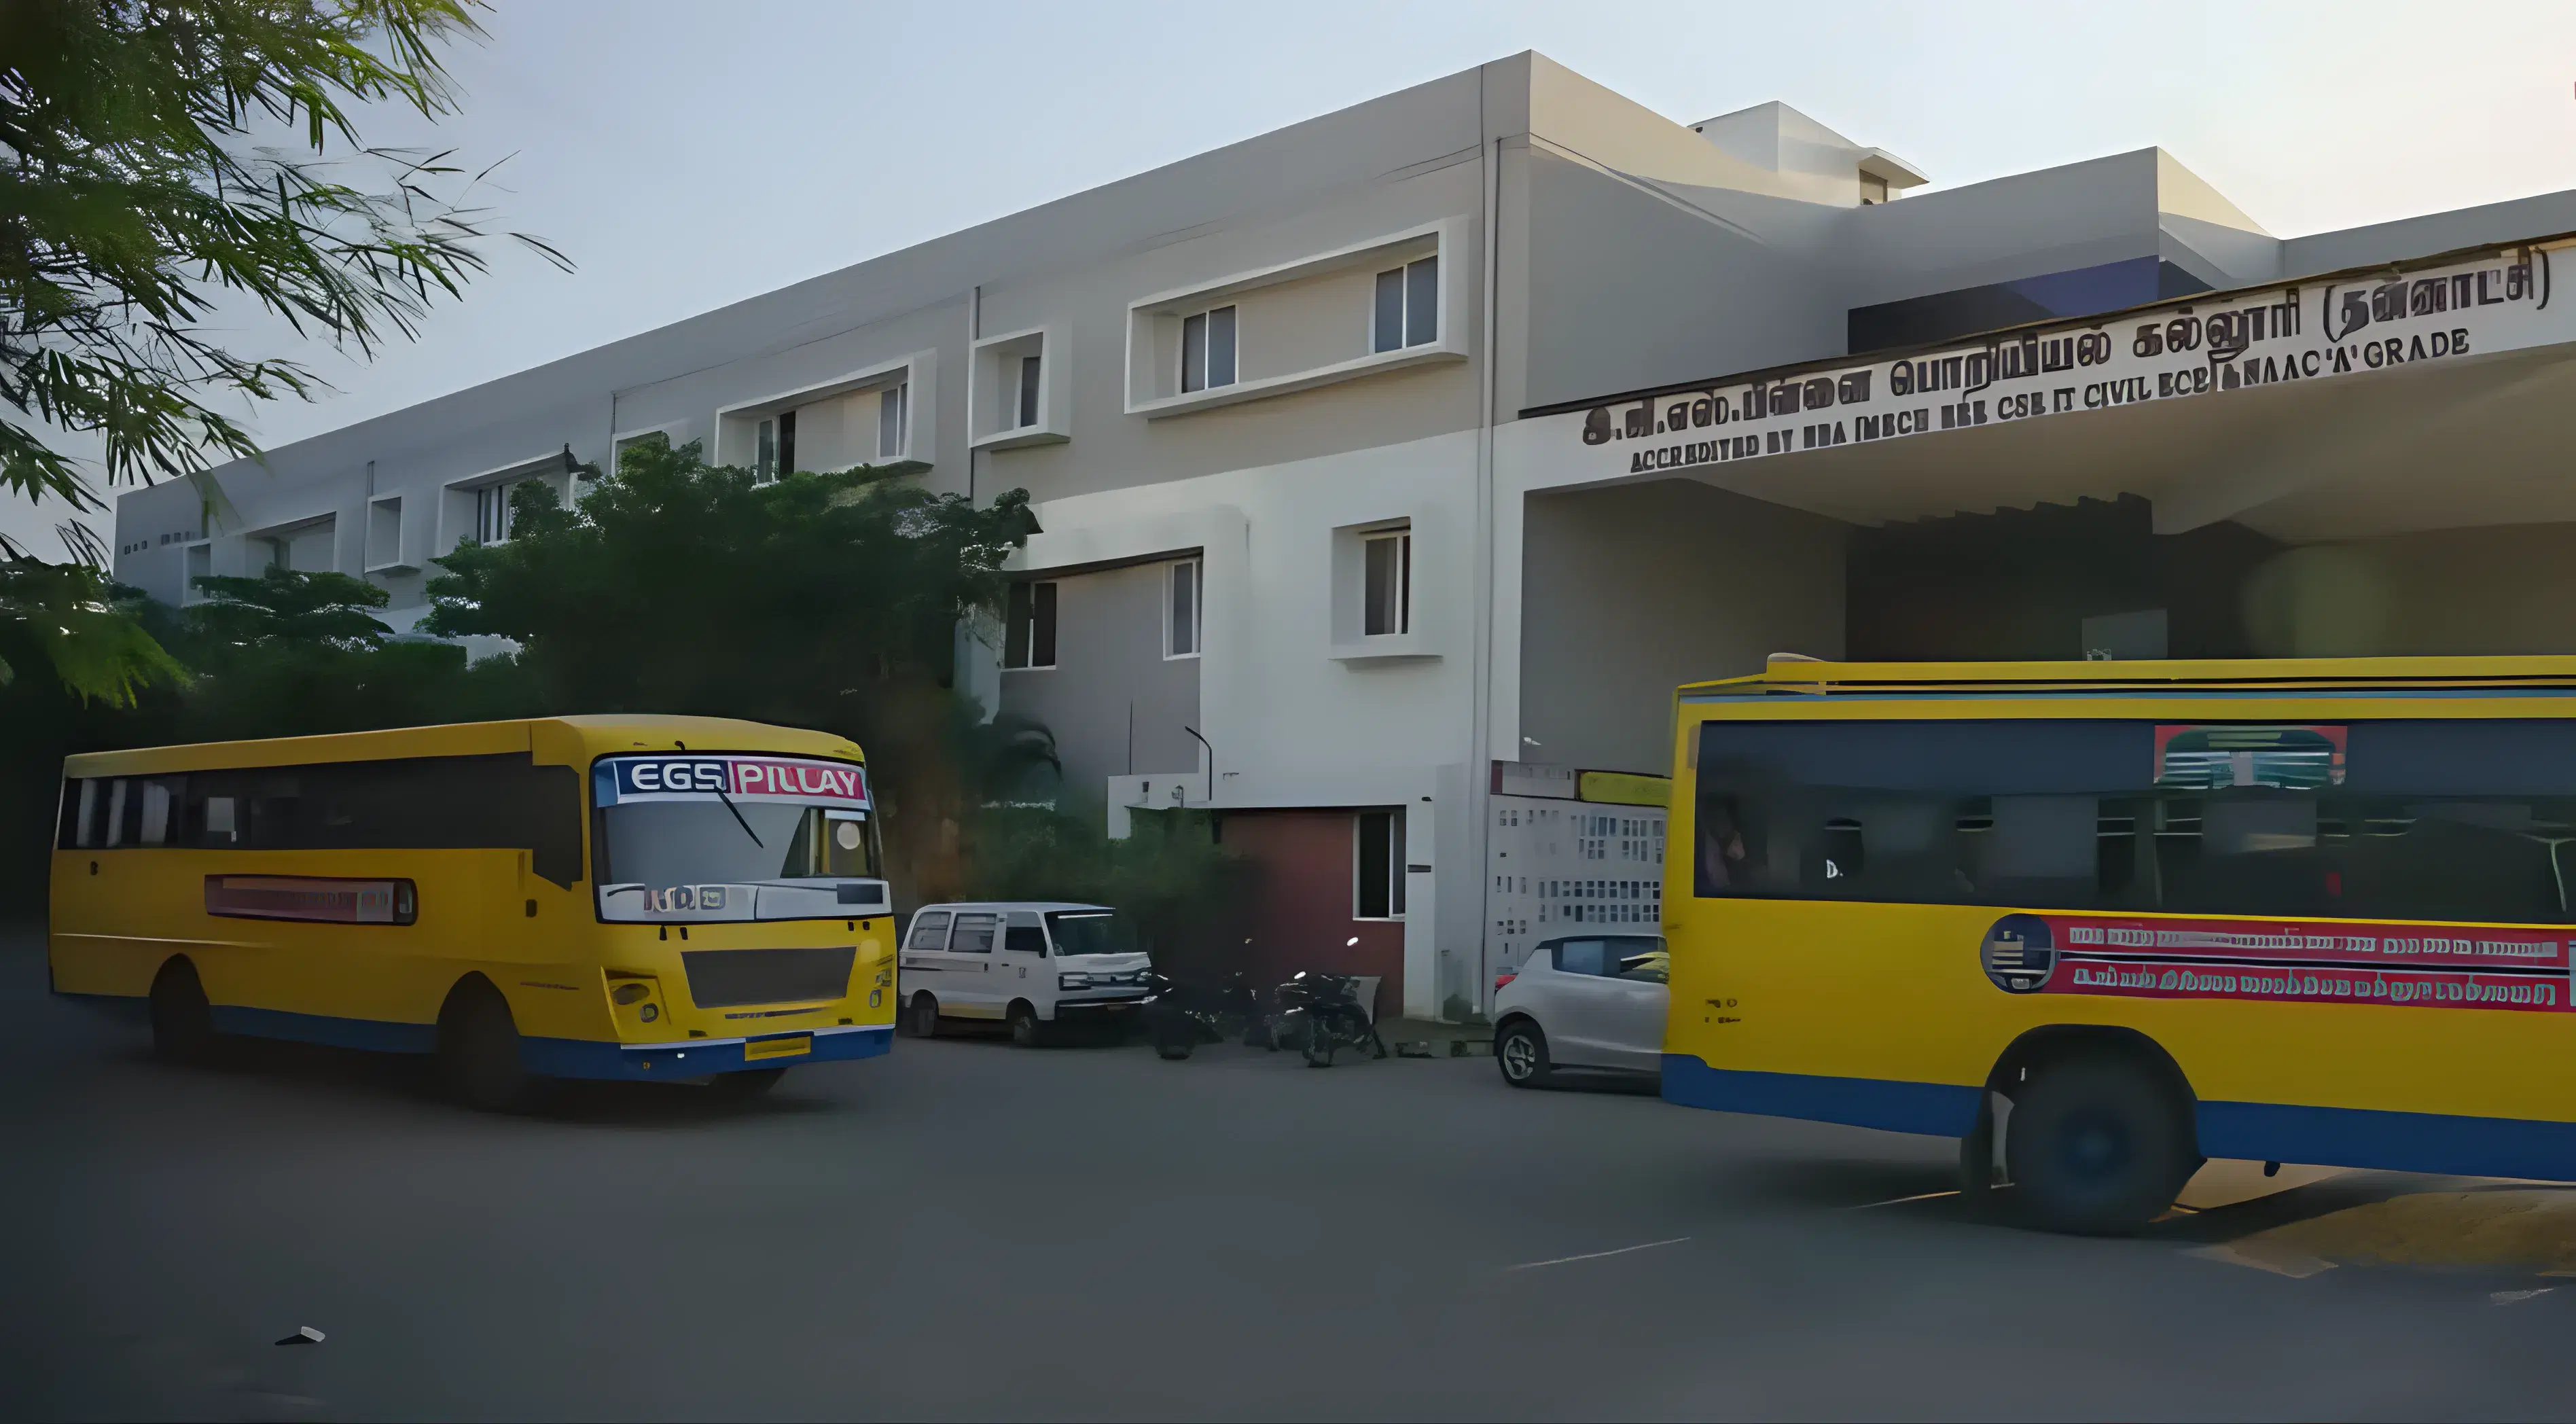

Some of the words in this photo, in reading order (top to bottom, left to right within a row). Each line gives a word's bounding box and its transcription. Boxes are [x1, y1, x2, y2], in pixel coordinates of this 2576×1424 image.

[2084, 376, 2152, 408] CIVIL
[2364, 328, 2469, 368] GRADE
[631, 764, 726, 791] EGS
[736, 764, 858, 796] PILLAY
